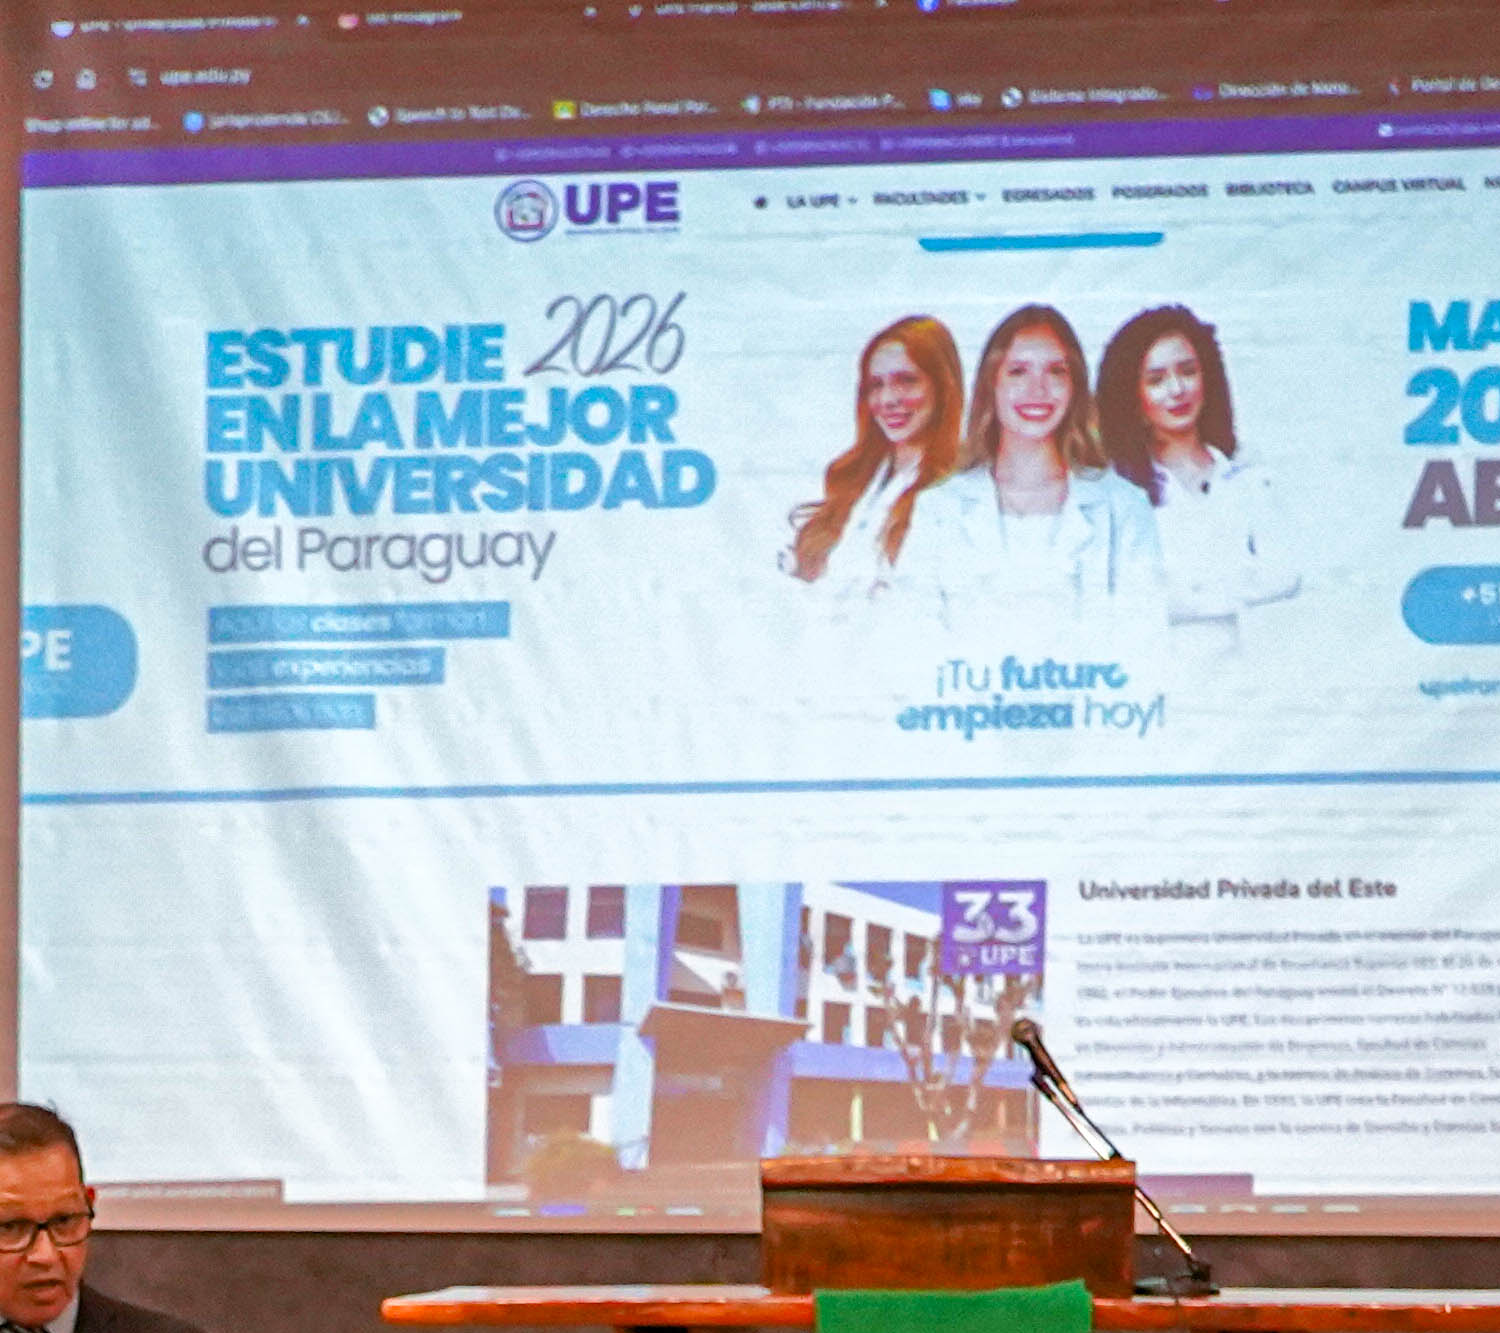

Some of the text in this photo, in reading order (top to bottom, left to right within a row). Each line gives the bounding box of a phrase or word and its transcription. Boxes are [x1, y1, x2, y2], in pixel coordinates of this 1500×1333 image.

[563, 181, 681, 225] UPE
[206, 292, 687, 389] ESTUDIE 2026
[206, 384, 679, 454] EN LA MEJOR
[205, 449, 717, 518] UNIVERSIDAD
[203, 526, 557, 583] del Paraguay
[896, 692, 1166, 741] empieza hoy!
[1079, 878, 1397, 900] Universidad Privada del Este
[952, 890, 1039, 943] 33
[981, 945, 1038, 967] UPE
